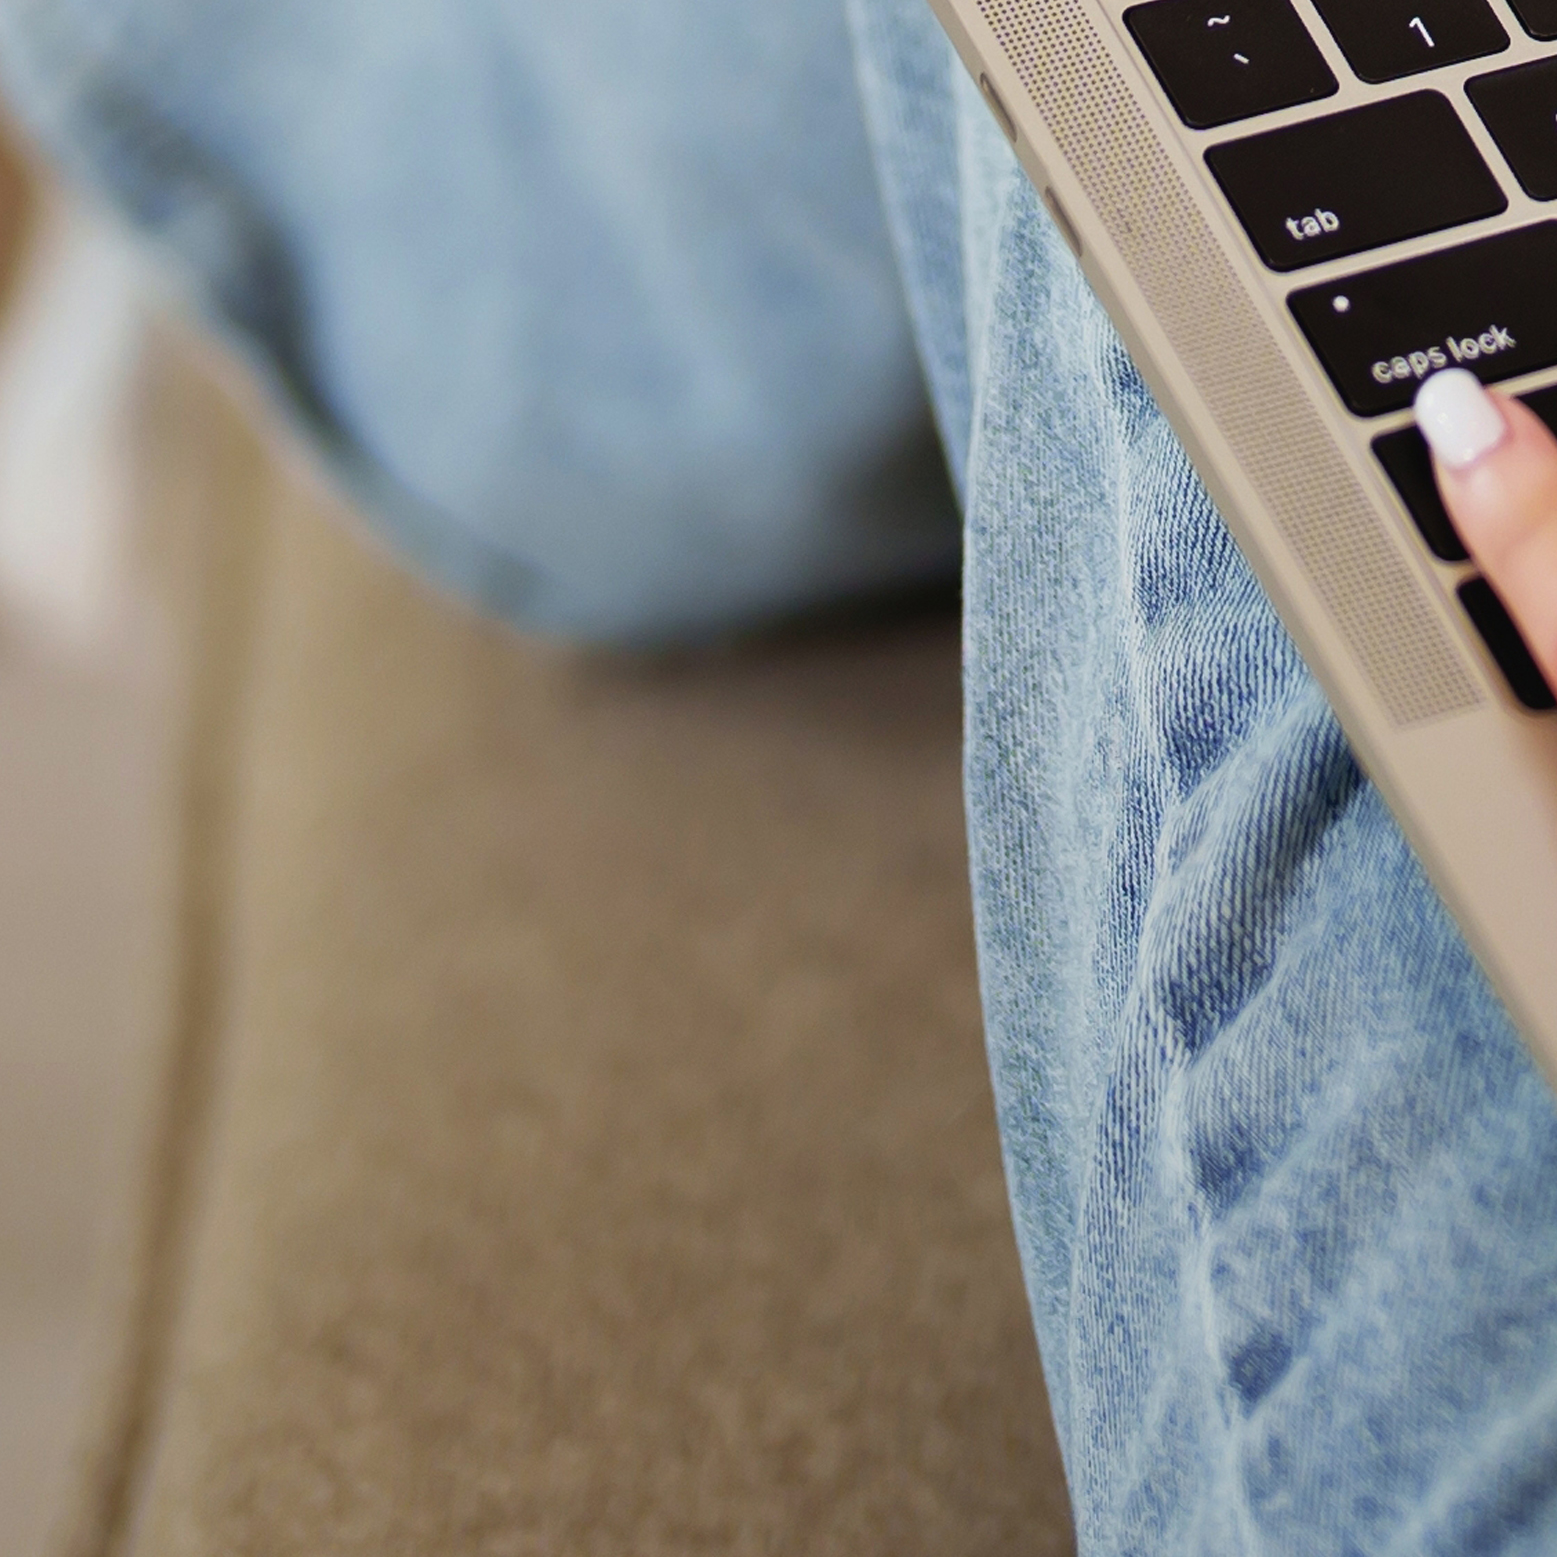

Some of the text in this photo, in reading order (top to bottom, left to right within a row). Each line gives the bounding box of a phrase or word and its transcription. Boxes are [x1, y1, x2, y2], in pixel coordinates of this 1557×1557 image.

[1409, 17, 1434, 47] 1
[1286, 209, 1339, 239] tab
[1371, 324, 1516, 384] caps lock
